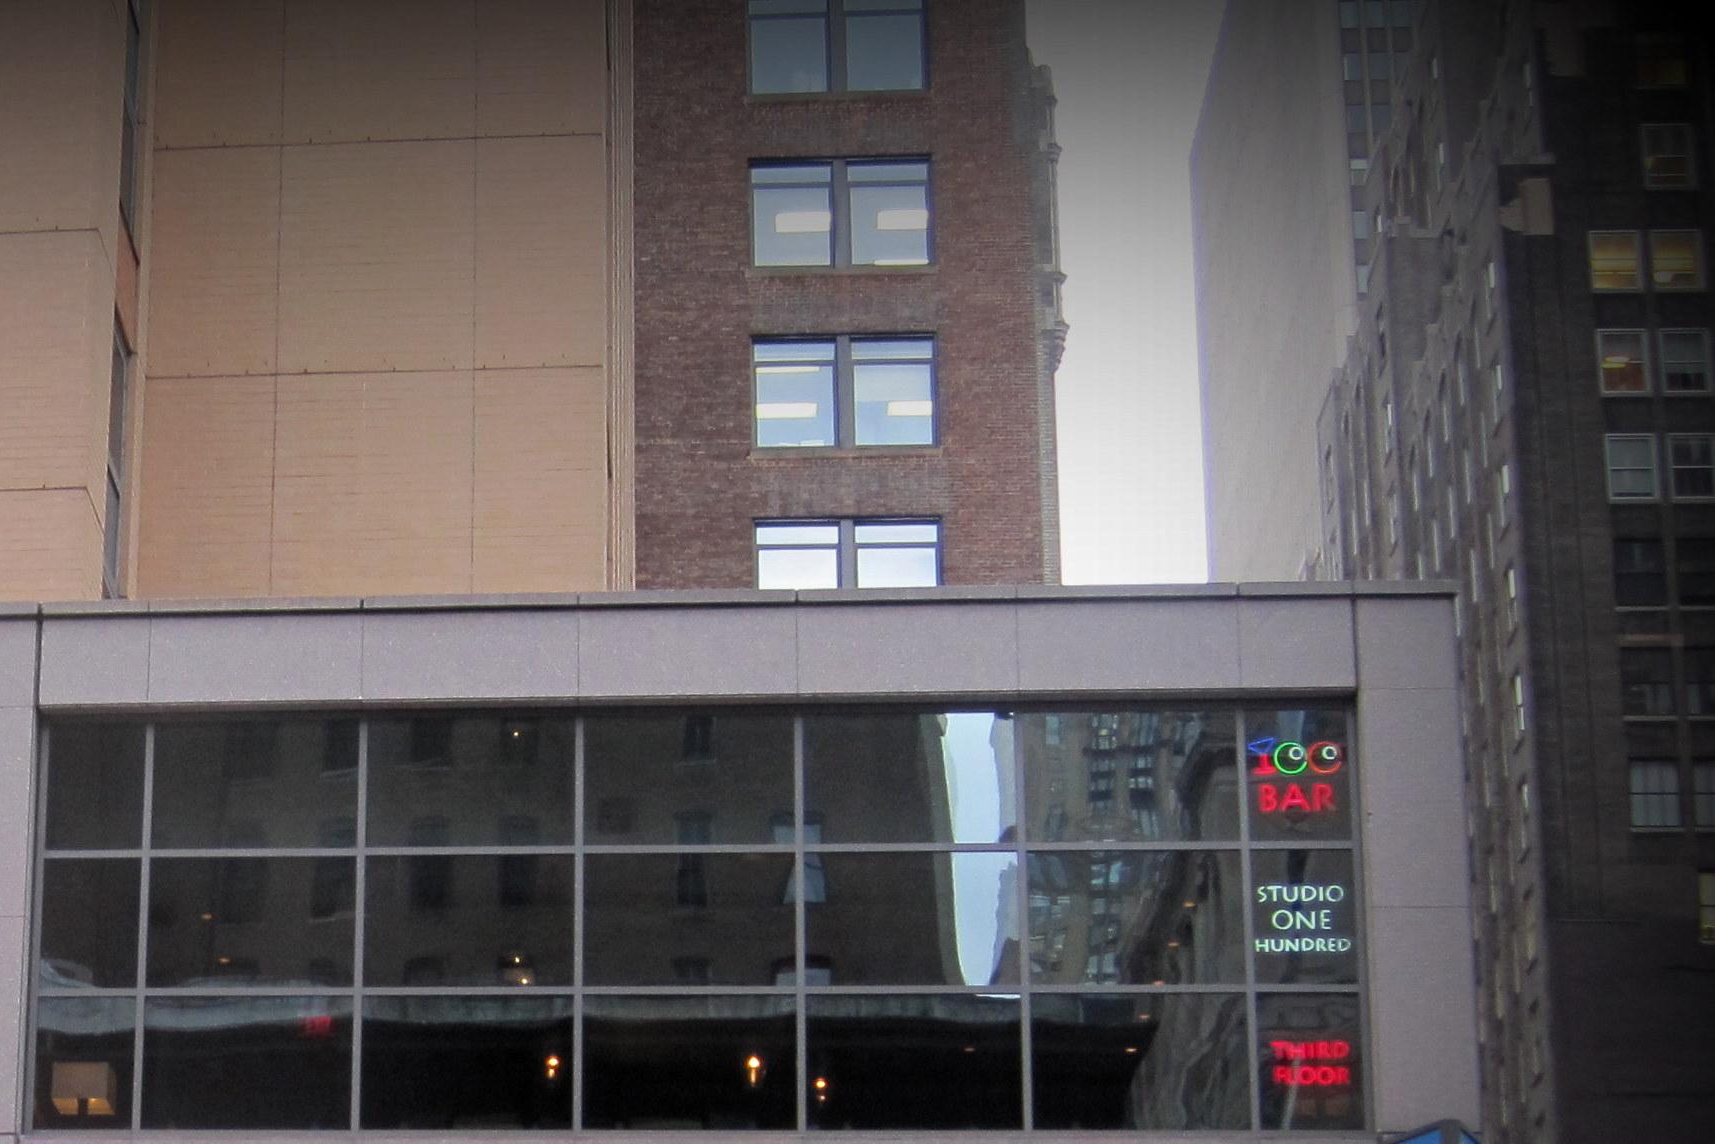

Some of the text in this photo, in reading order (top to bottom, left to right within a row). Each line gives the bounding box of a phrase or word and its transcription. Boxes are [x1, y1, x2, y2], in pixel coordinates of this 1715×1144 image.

[1258, 784, 1335, 812] BAR
[1257, 884, 1344, 904] STUDIO
[1271, 909, 1332, 931] ONE
[1255, 937, 1351, 954] HUNDRED
[1270, 1040, 1350, 1060] THIRD
[1272, 1066, 1350, 1086] FLOOR
